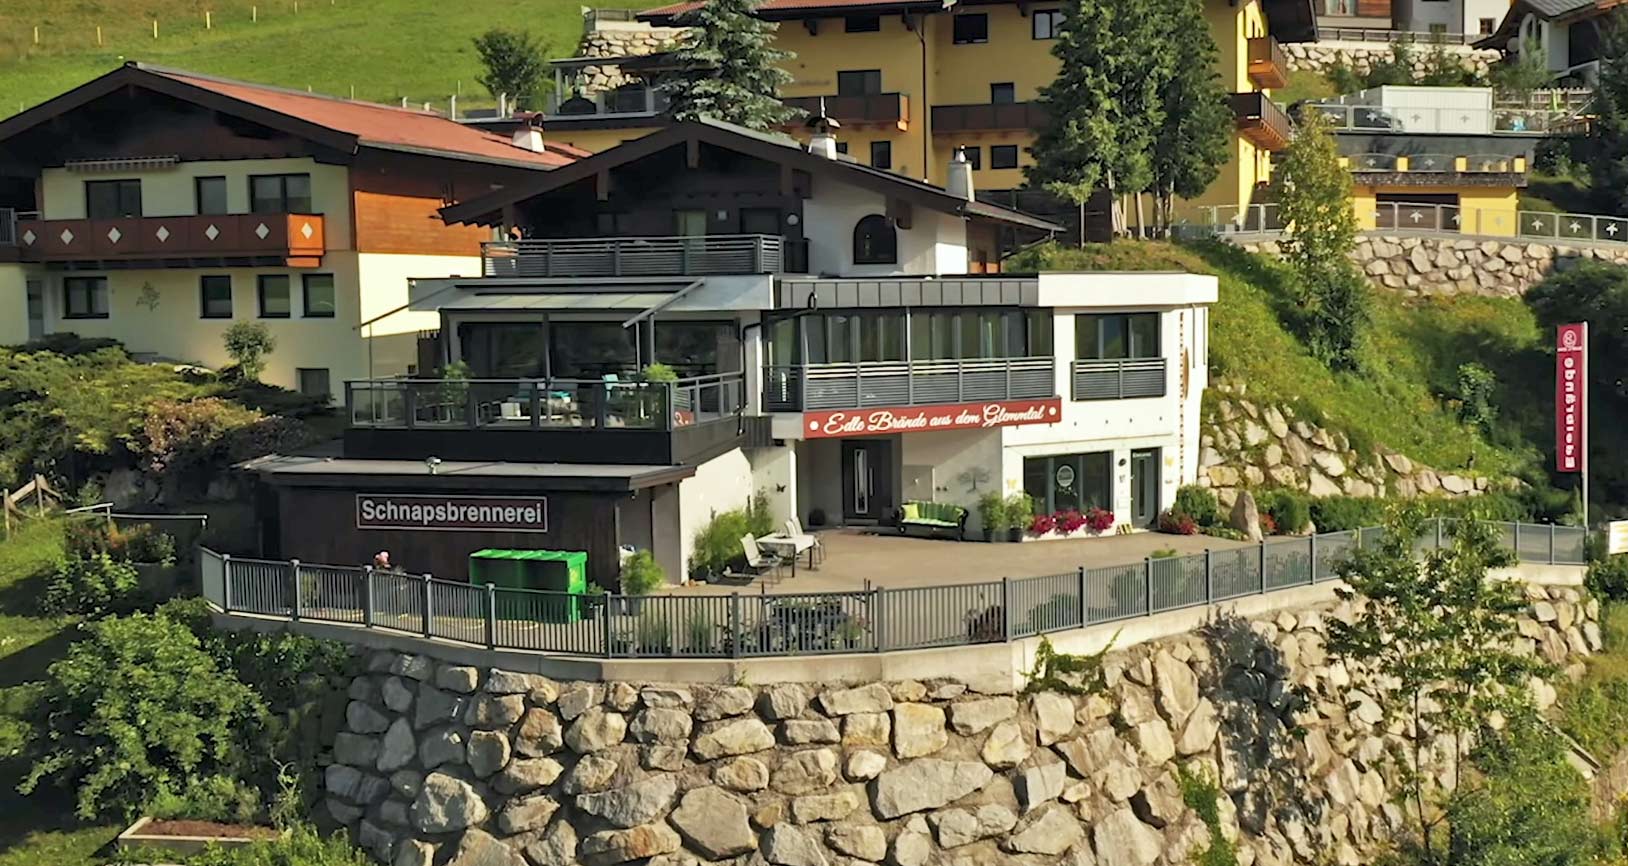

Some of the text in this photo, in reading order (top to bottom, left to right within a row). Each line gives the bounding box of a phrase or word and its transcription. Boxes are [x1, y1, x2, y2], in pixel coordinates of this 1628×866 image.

[823, 404, 1046, 434] Edle Brände aus dem Glemmtal
[362, 499, 542, 525] Schnapsbrennerei
